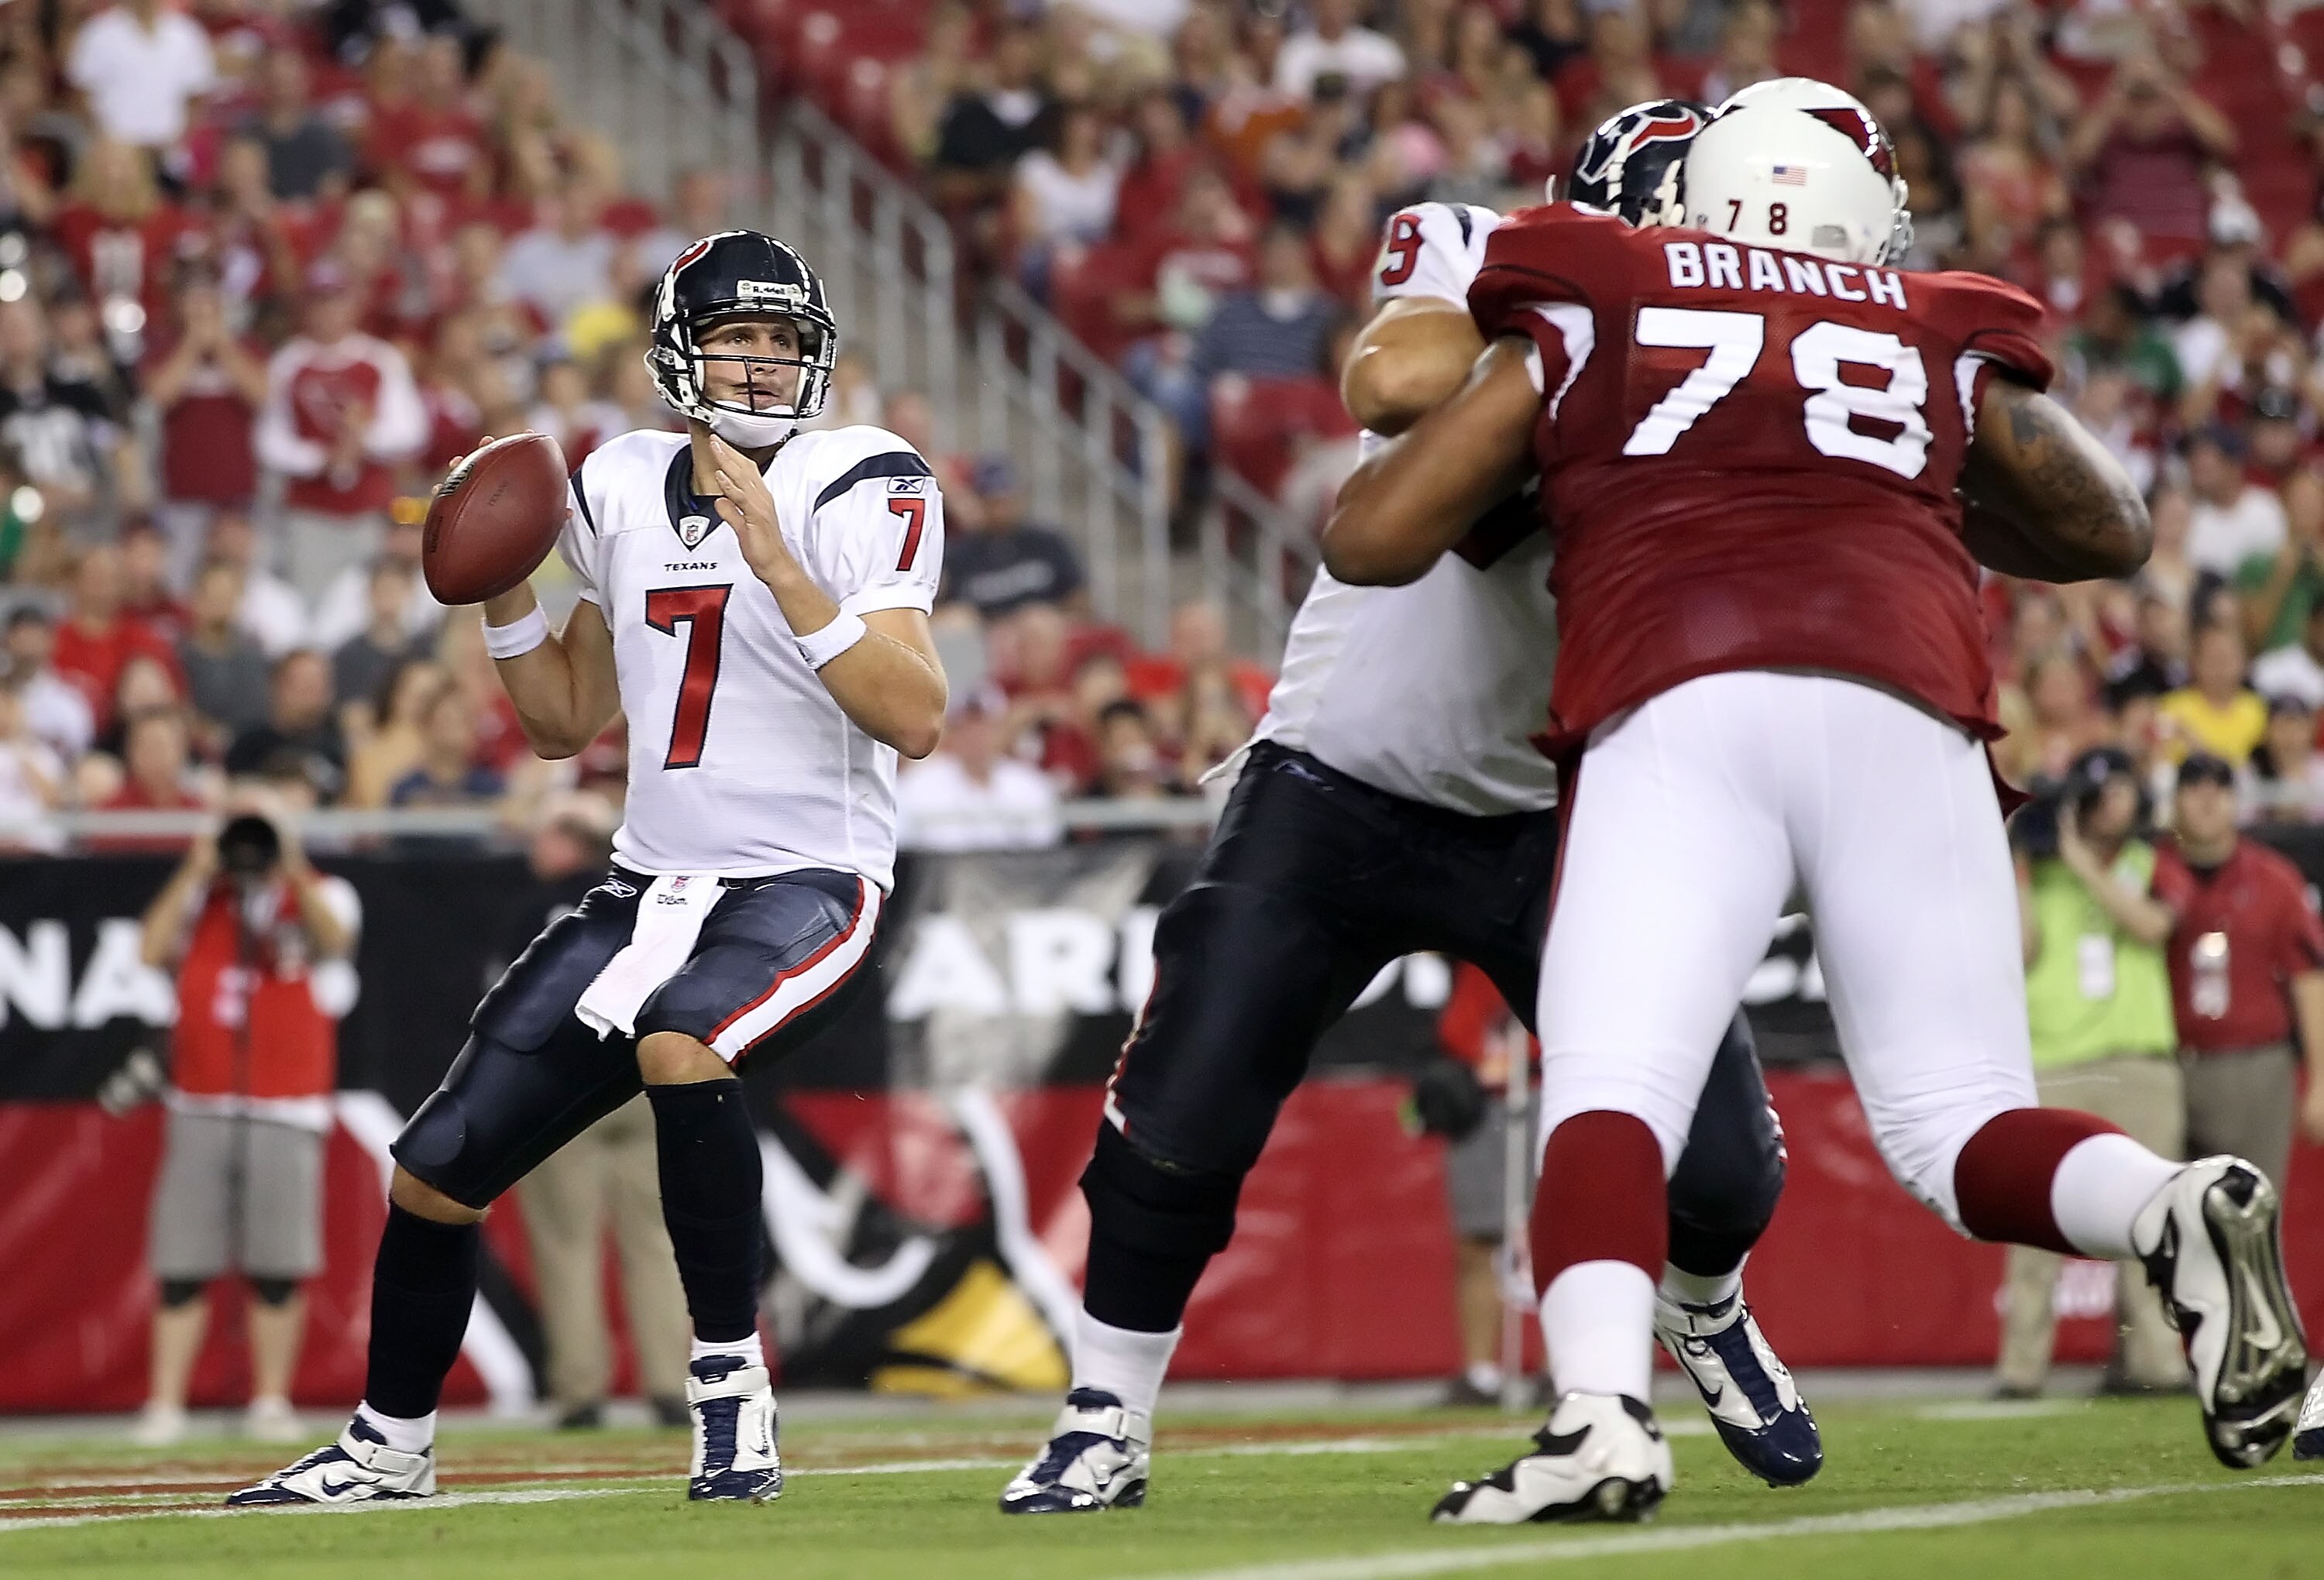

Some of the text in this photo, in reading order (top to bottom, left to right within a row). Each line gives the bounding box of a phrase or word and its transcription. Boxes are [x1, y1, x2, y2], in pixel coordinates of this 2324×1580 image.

[1381, 214, 1424, 286] 9
[1664, 242, 1907, 311] BRANCH
[1622, 307, 1934, 480] 78
[664, 562, 719, 572] TEXANS
[887, 498, 926, 572] 7
[645, 583, 734, 771] 7
